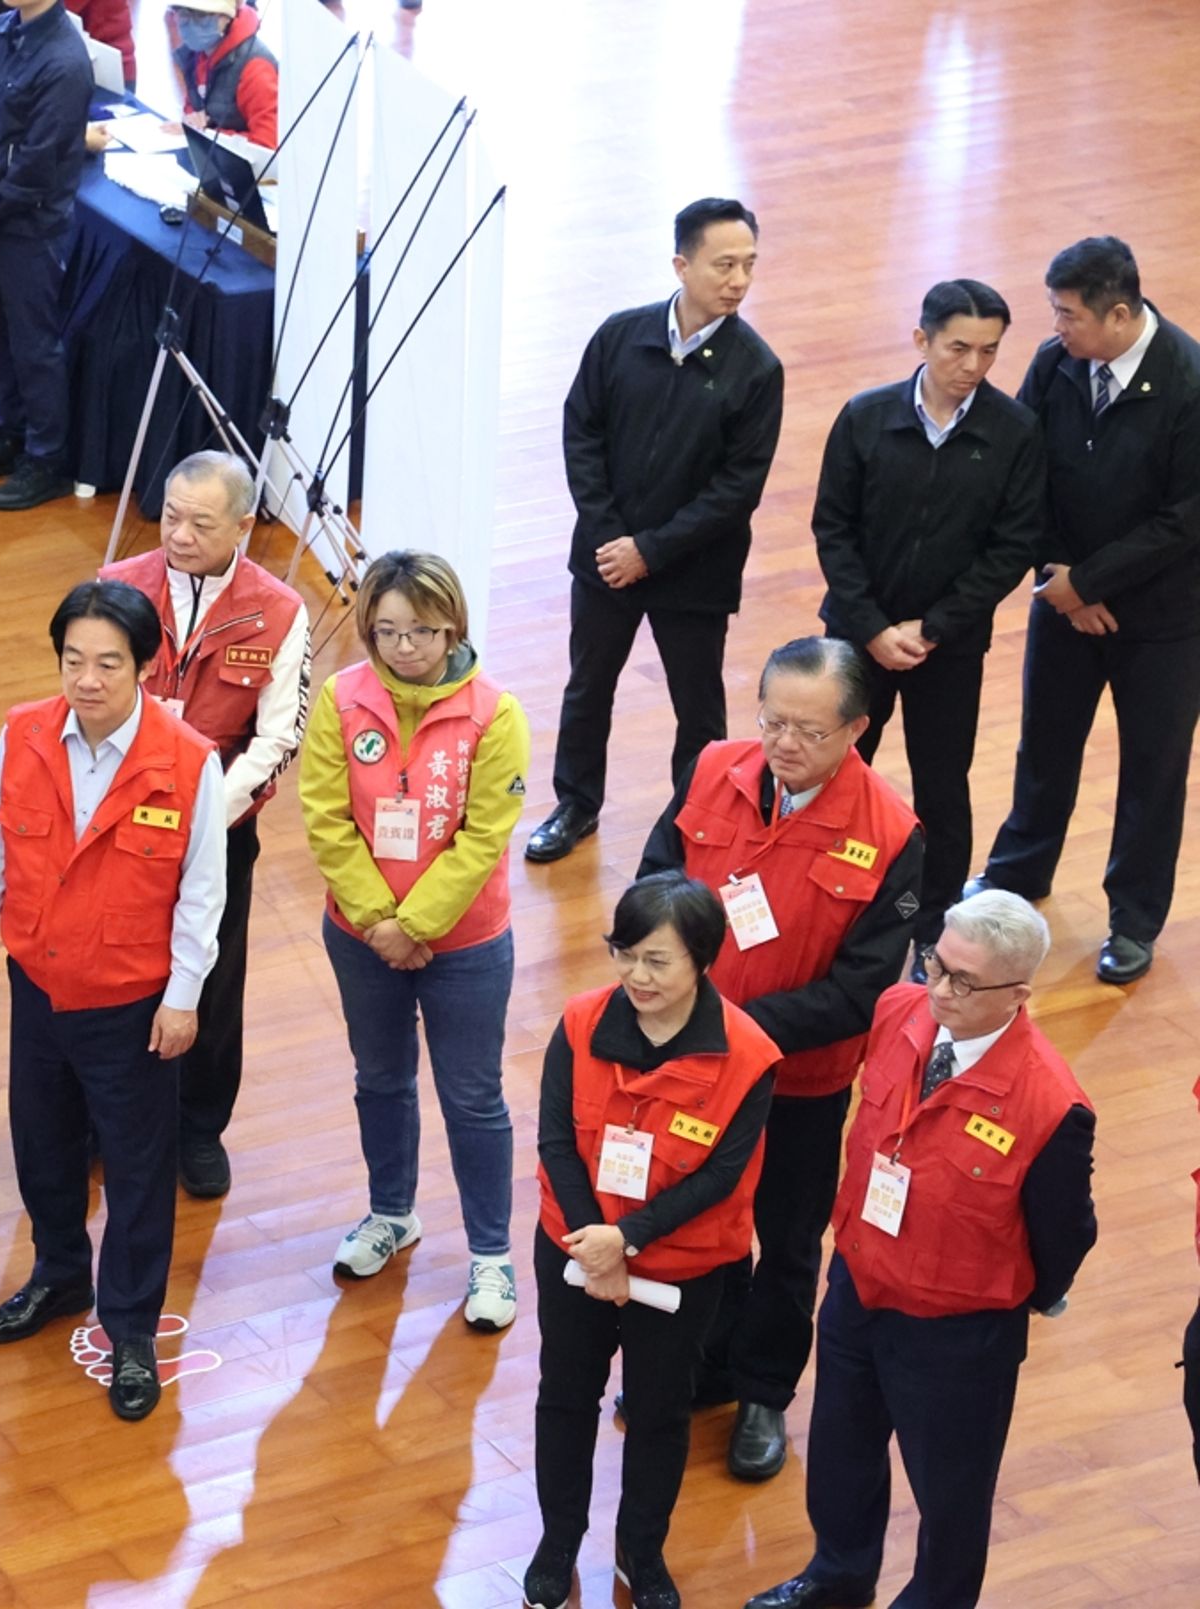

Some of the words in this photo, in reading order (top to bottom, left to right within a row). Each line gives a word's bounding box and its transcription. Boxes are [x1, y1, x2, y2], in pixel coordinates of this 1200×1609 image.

[425, 749, 453, 841] 黃淑君
[674, 1119, 713, 1139] 內政部
